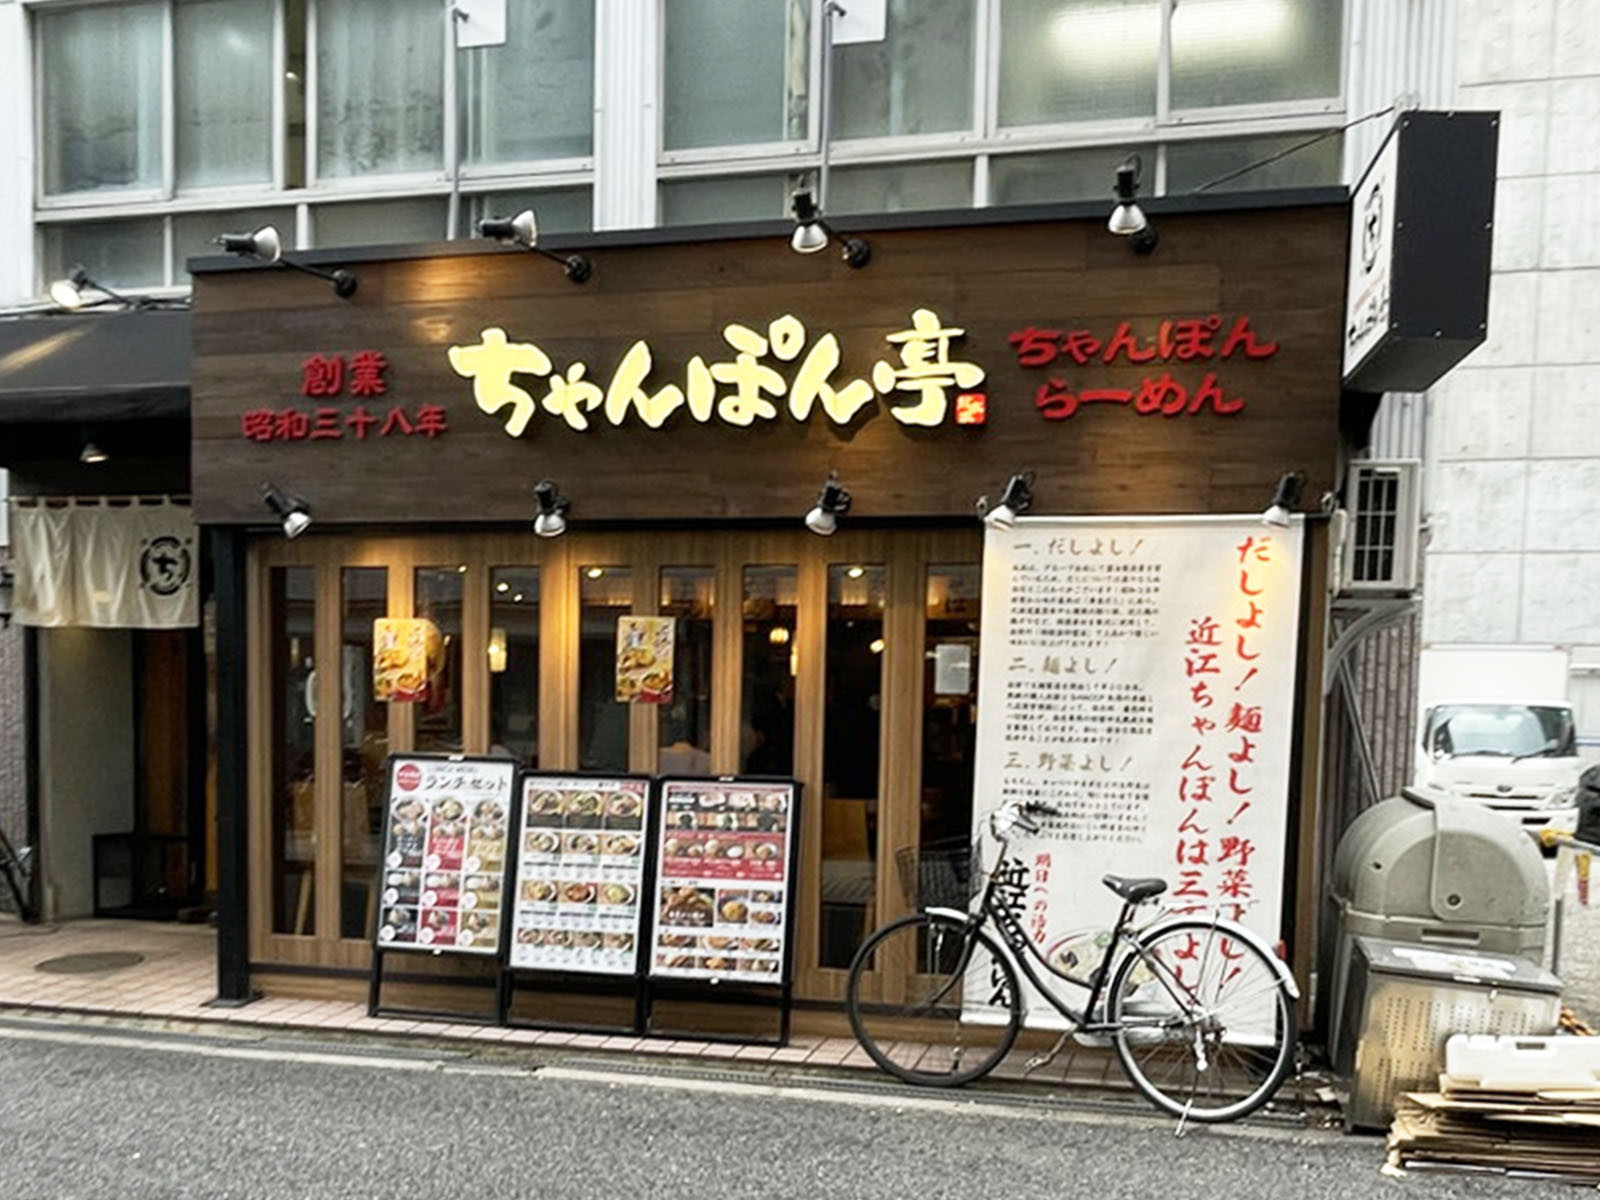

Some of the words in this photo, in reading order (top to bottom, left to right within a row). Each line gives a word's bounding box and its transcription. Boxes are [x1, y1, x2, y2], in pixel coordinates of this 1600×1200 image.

[1008, 315, 1278, 366] ちゃんぽん
[300, 351, 388, 396] 創業
[448, 308, 985, 437] ちゃんぽん亭
[1035, 373, 1246, 419] らーめん
[241, 403, 449, 441] 昭和三十八年
